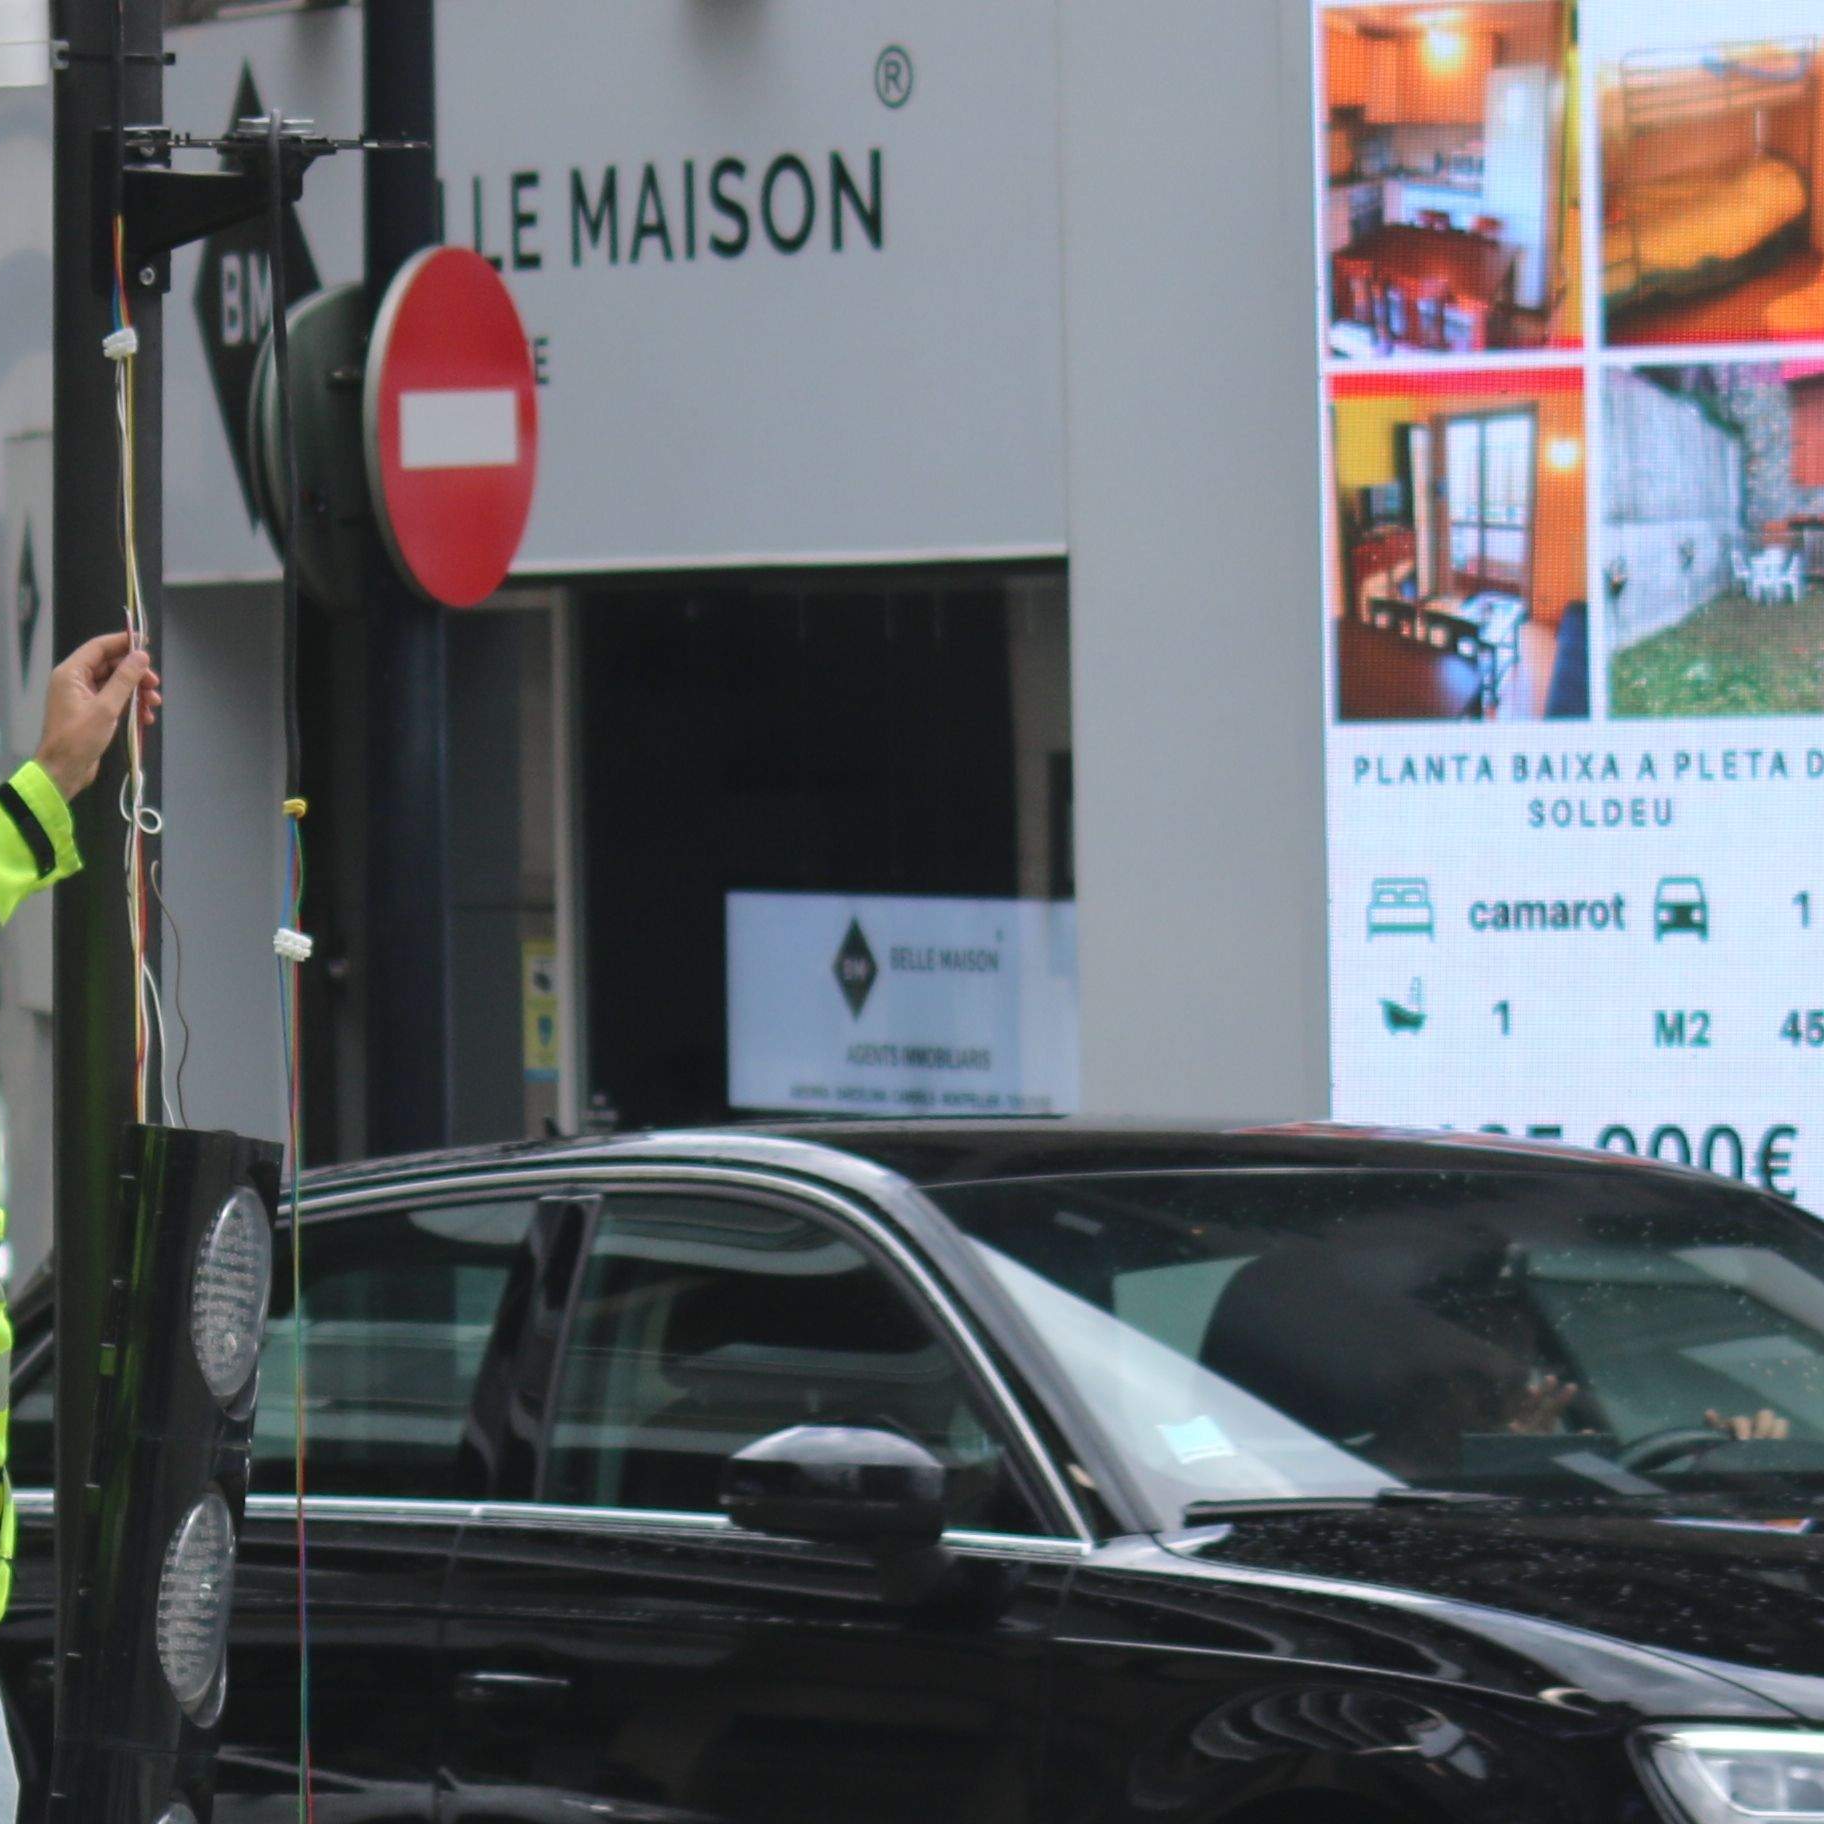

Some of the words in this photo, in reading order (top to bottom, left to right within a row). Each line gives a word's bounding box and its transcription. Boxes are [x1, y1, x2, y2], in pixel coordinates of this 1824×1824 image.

[569, 148, 884, 268] MAISON
[1353, 753, 1495, 786] PLANTA
[1512, 751, 1619, 784] BAIXA
[1636, 751, 1658, 782] A
[1674, 748, 1788, 781] PLETA
[1529, 798, 1673, 829] SOLDEU
[1468, 890, 1626, 932] camarot
[1792, 890, 1813, 928] 1
[890, 946, 935, 972] BELLE
[939, 948, 999, 974] MAISON
[1491, 1000, 1512, 1036] 1
[1654, 1009, 1712, 1048] M2
